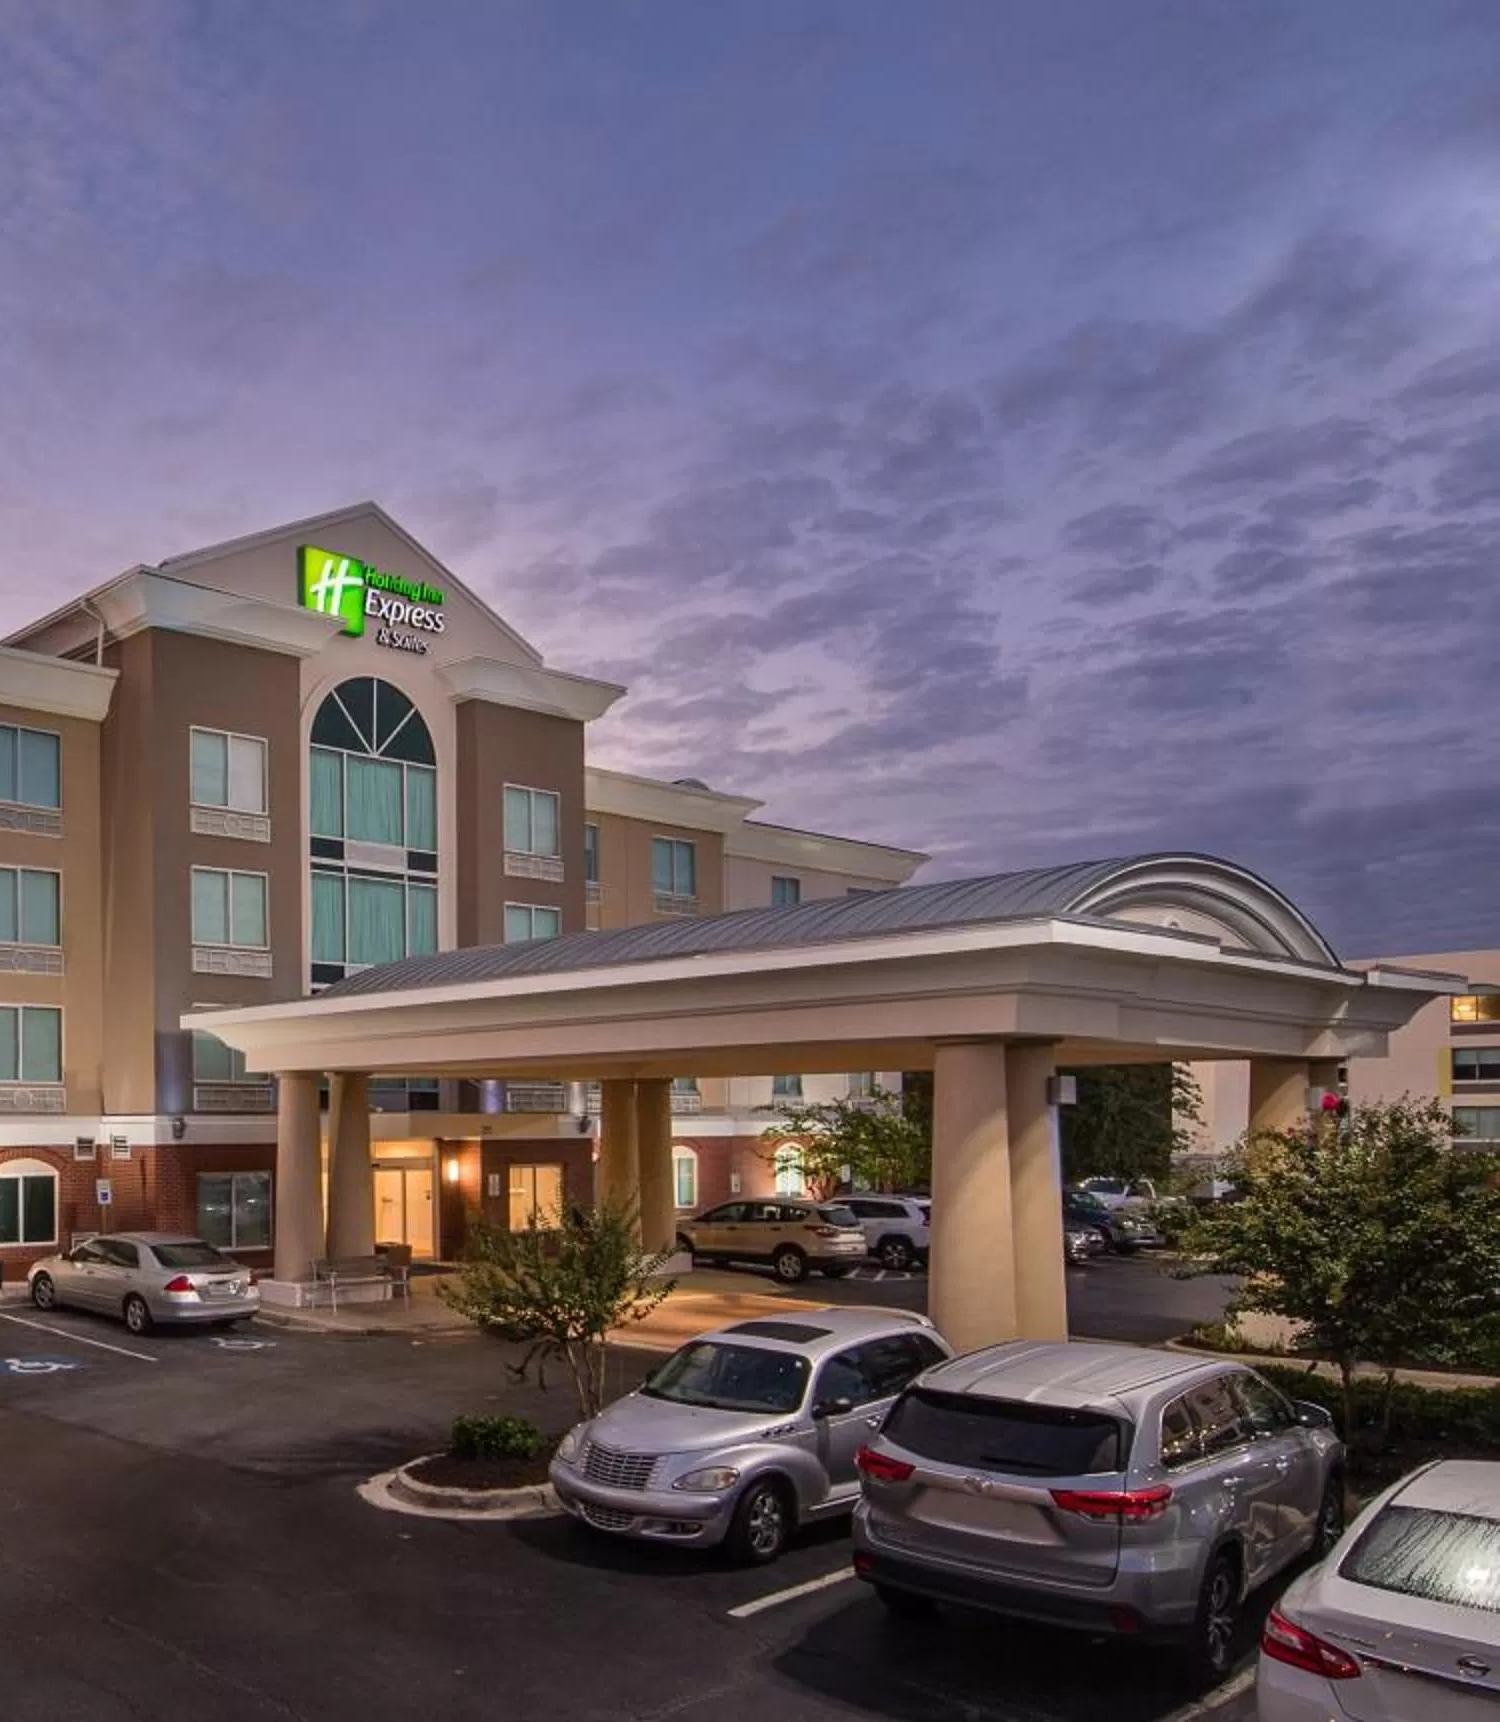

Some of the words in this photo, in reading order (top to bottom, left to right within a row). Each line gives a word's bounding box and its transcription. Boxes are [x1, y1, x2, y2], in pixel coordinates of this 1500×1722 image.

[365, 565, 420, 602] Holiday
[422, 582, 445, 605] Inn
[365, 587, 445, 633] Express
[378, 627, 389, 644] &
[391, 631, 430, 655] Suites
